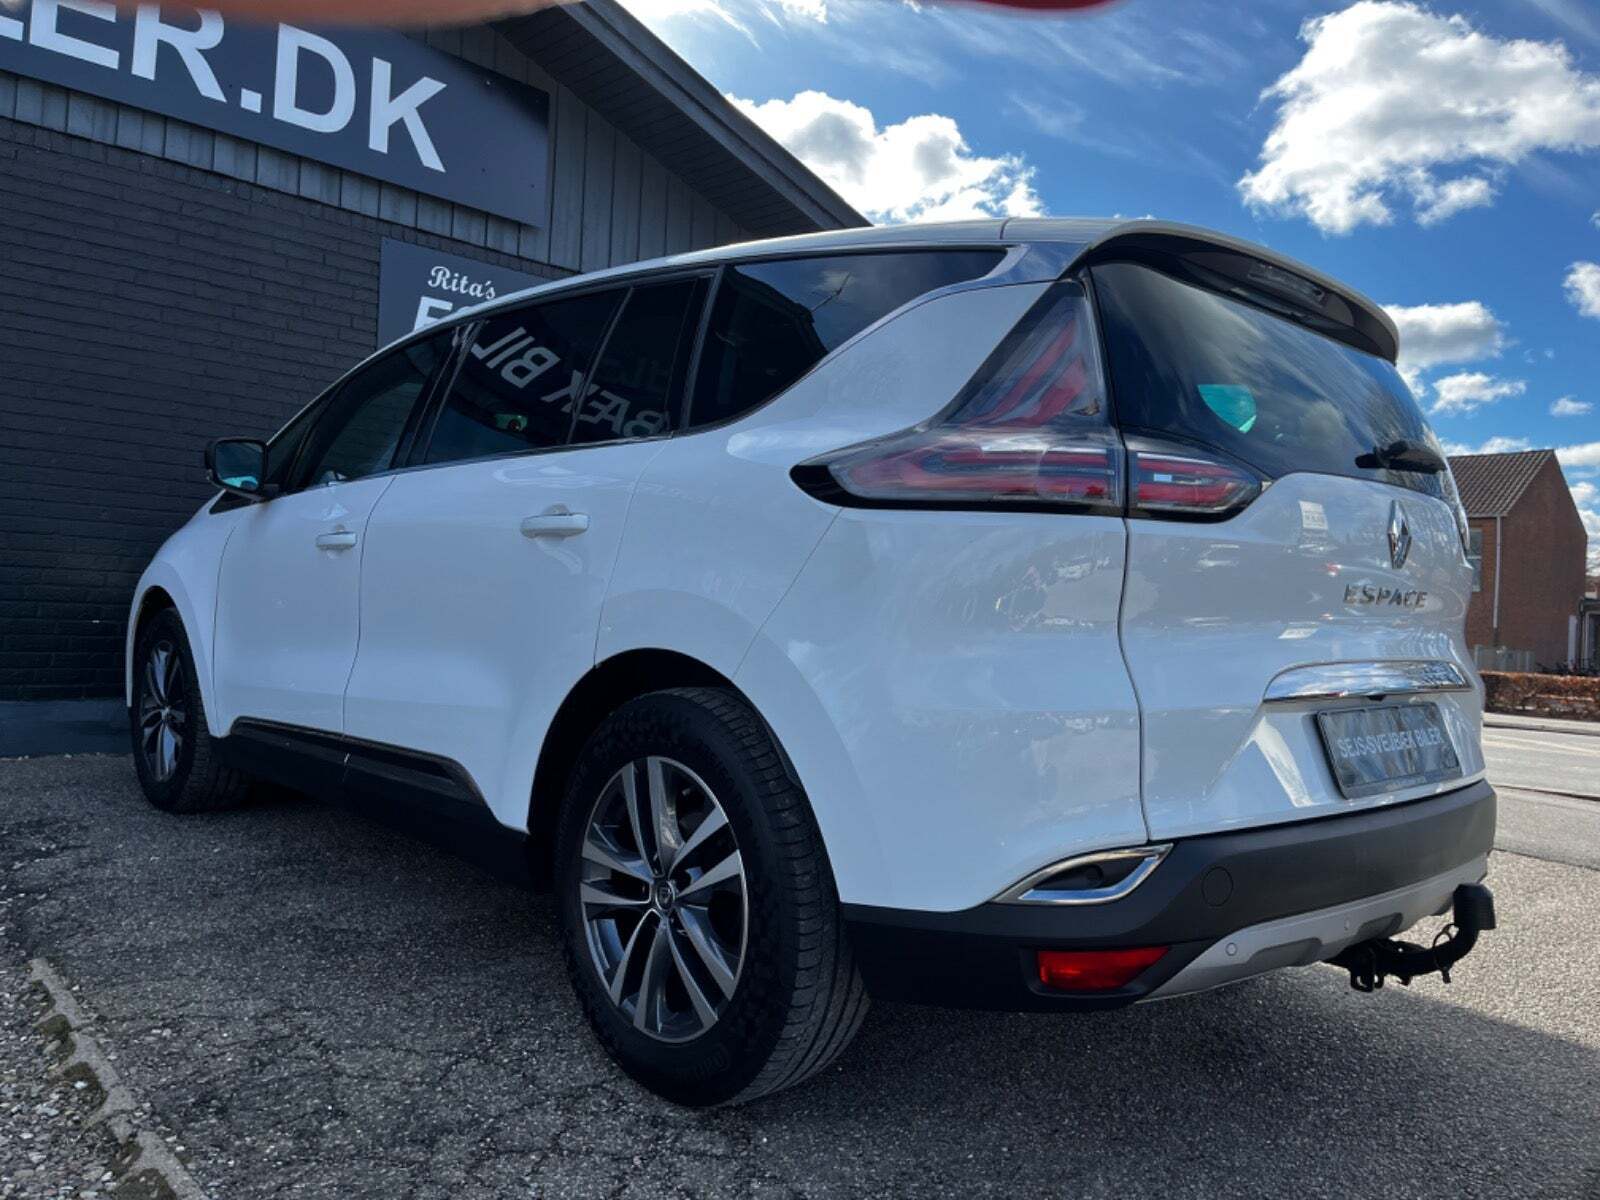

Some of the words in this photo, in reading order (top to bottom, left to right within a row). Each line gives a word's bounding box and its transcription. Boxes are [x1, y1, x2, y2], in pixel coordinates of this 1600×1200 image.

[0, 0, 447, 173] ER.DK
[427, 265, 496, 300] Rita's
[1342, 583, 1428, 608] ESPACE
